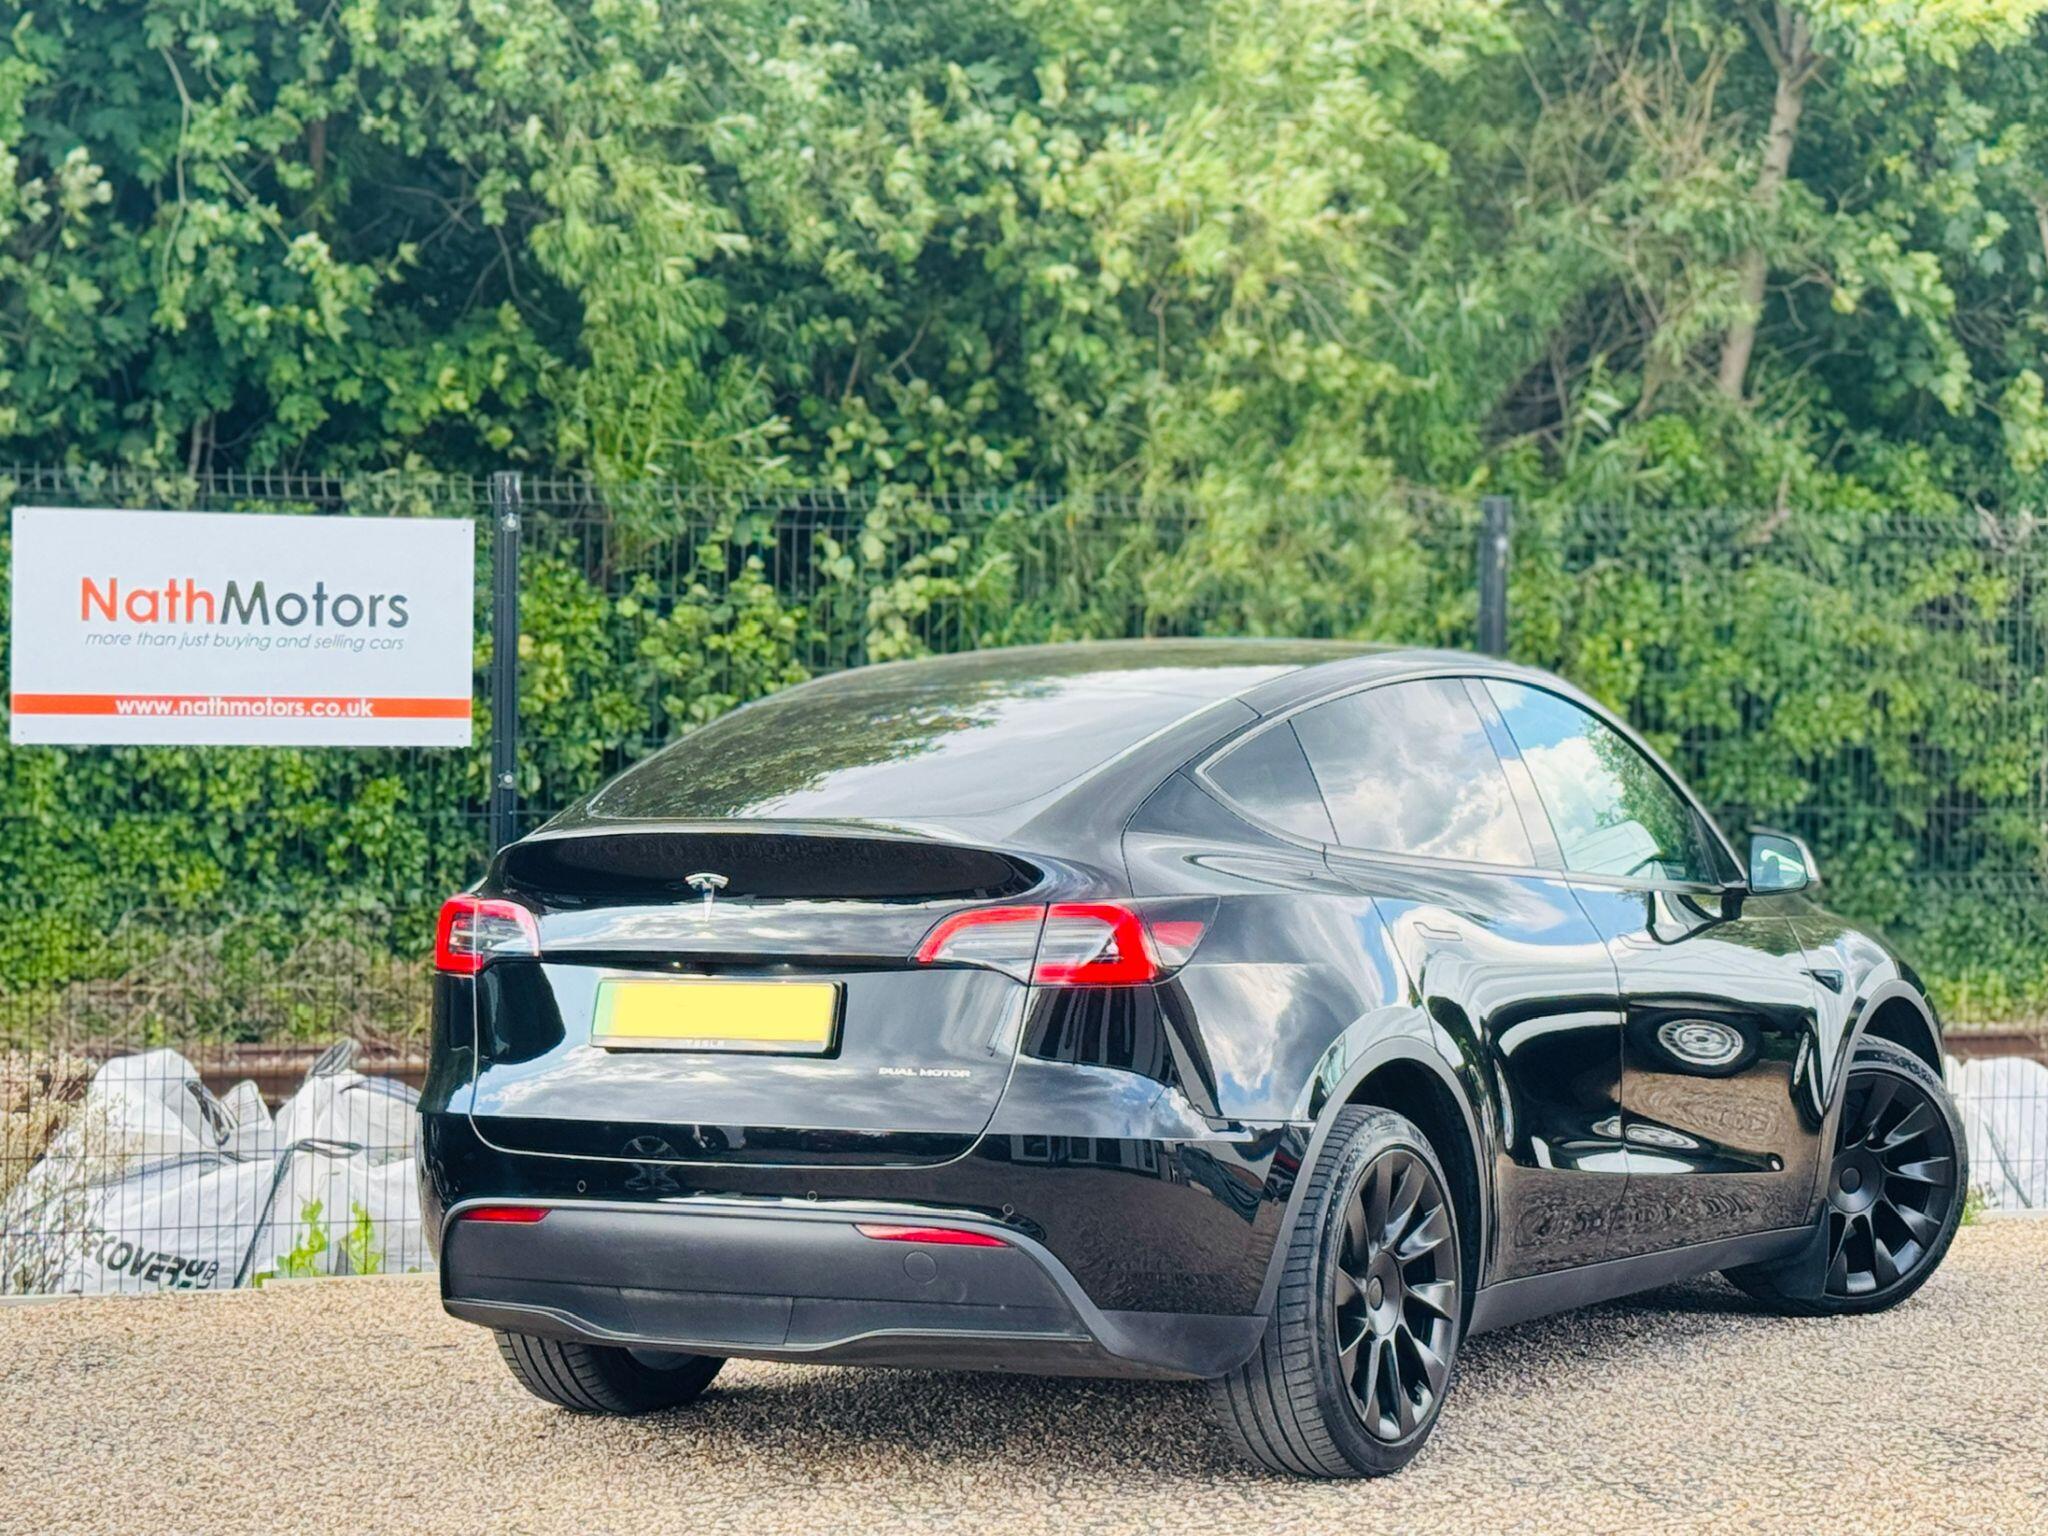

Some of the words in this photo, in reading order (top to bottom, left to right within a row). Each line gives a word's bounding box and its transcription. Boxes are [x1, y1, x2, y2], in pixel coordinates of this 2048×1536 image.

[81, 576, 409, 628] NathMotors
[85, 633, 132, 646] more
[137, 632, 176, 647] than
[178, 631, 210, 650] just
[213, 633, 271, 651] buying
[276, 634, 312, 649] and
[314, 634, 365, 653] selling
[369, 637, 405, 650] cars
[115, 696, 373, 718] www.nathmotors.co.uk
[878, 1066, 918, 1077] DUAL
[920, 1067, 971, 1078] MOTOR
